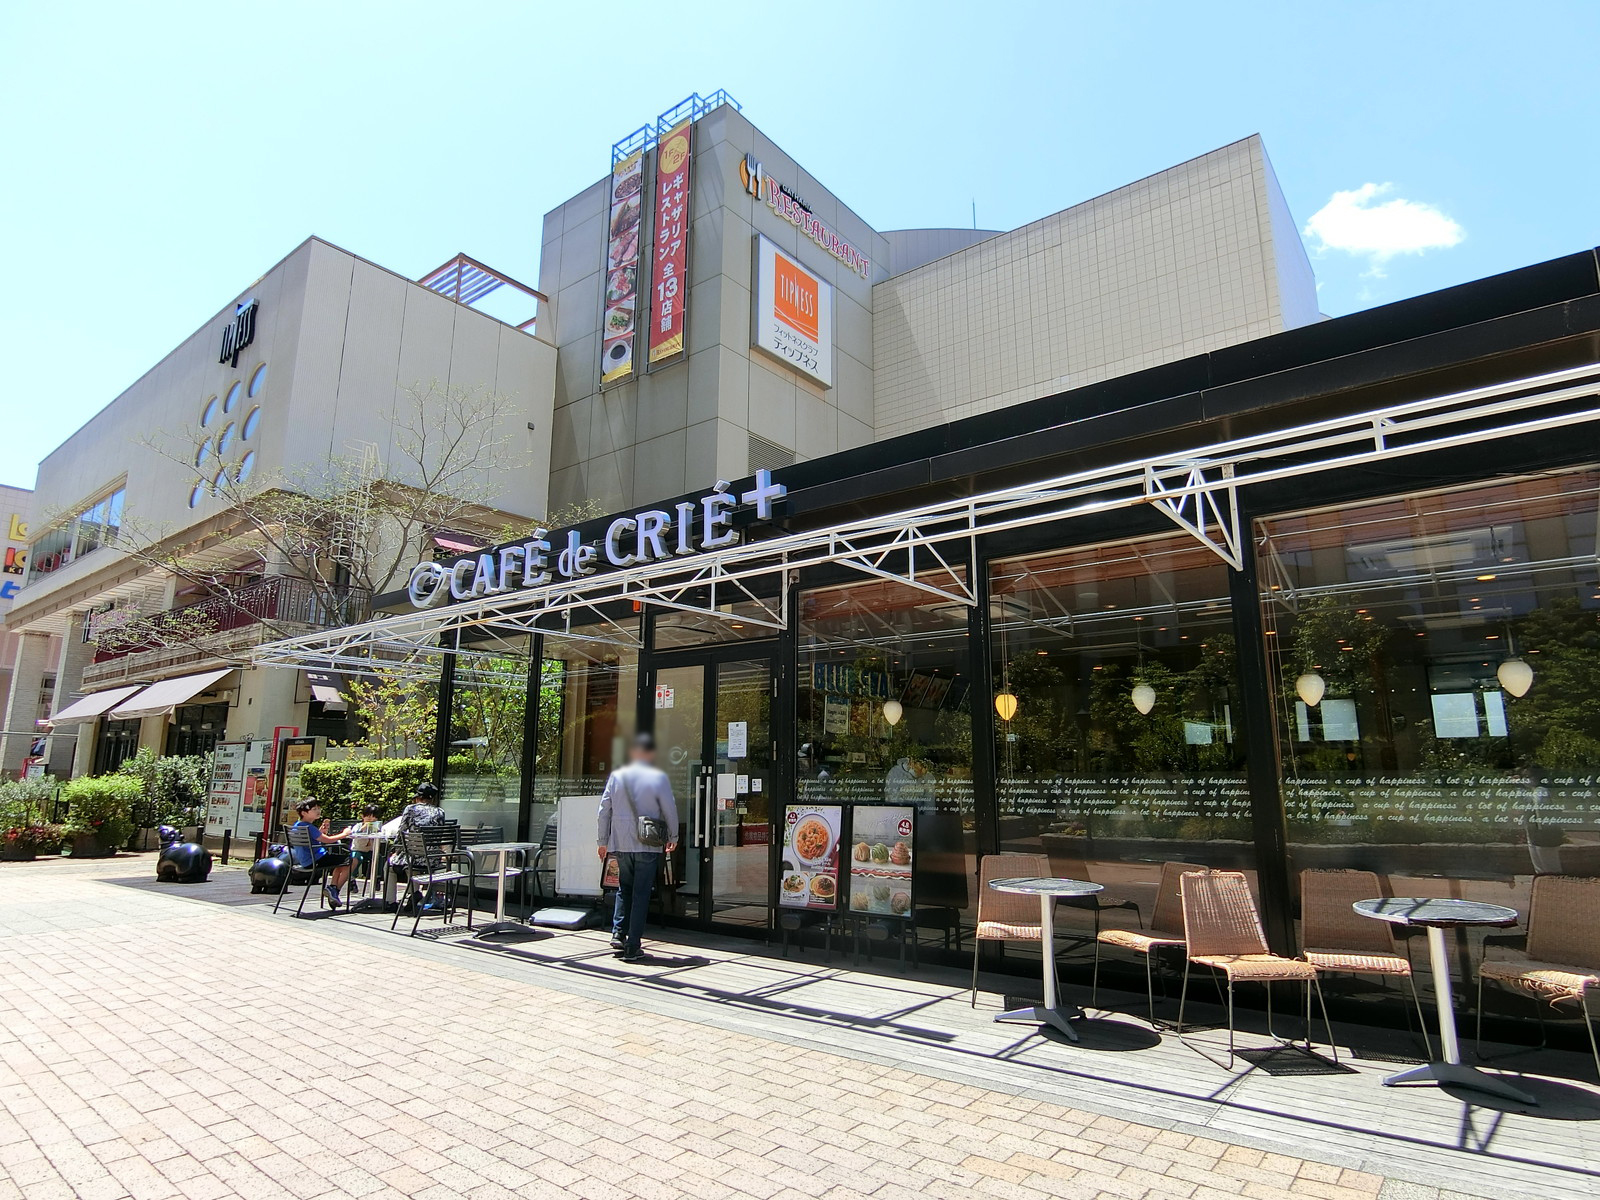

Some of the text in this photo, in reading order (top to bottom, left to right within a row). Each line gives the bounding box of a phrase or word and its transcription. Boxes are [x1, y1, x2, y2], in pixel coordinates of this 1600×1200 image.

[670, 172, 684, 256] ギャザリア
[659, 182, 672, 261] レストラン
[766, 175, 870, 277] RESTAURANT
[780, 273, 814, 318] TIPNESS
[450, 528, 552, 601] CAFÉ
[558, 530, 598, 578] de
[1064, 777, 1096, 785] happiness
[1131, 777, 1166, 785] happiness
[1208, 777, 1247, 786] happiness
[1285, 777, 1327, 786] happiness
[1379, 776, 1426, 786] happiness
[1479, 776, 1531, 786] happiness
[1008, 787, 1038, 795] happiness
[1074, 787, 1106, 795] happiness
[1142, 787, 1177, 796] happiness
[1298, 788, 1341, 798] happiness
[1394, 788, 1441, 798] happiness
[1495, 789, 1548, 799] happiness
[1017, 797, 1047, 805] happiness
[1083, 797, 1116, 806] happiness
[1152, 798, 1188, 806] happiness
[1311, 800, 1355, 810] happiness
[1409, 801, 1457, 810] happiness
[1512, 802, 1566, 812] happiness
[1026, 807, 1056, 815] happiness
[1092, 807, 1126, 816] happiness
[1163, 808, 1199, 817] happiness
[1324, 812, 1368, 822] happiness
[1423, 814, 1473, 823] happiness
[1528, 815, 1584, 825] happiness
